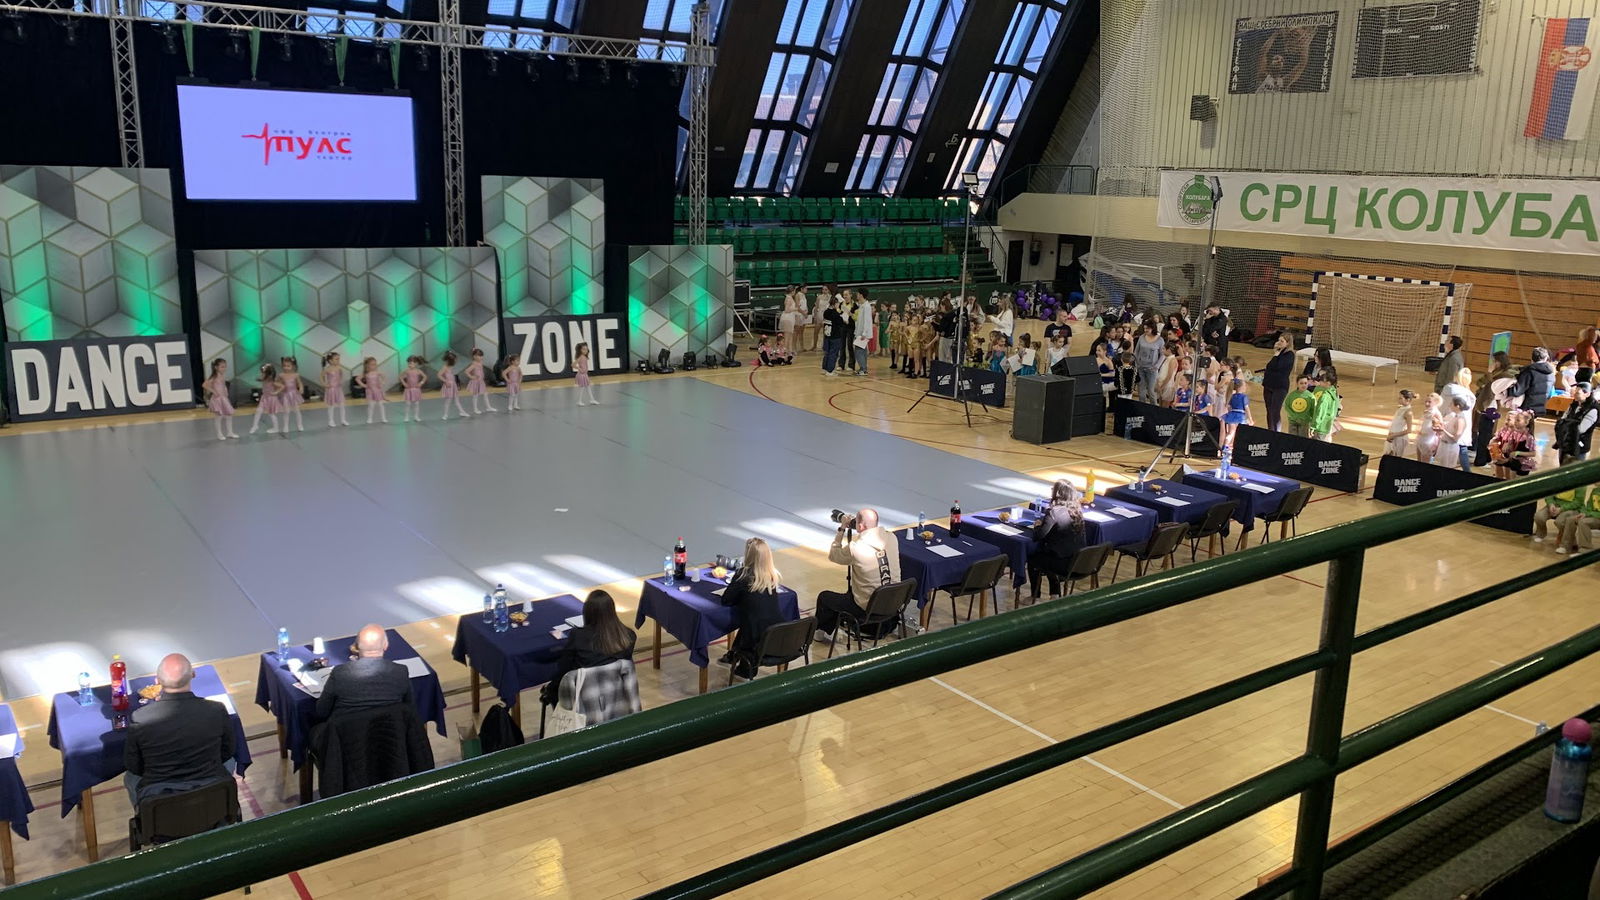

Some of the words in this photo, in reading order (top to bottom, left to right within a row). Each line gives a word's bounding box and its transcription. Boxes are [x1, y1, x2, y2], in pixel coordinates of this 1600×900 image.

[1231, 38, 1242, 91] СТЕФАН
[1239, 182, 1338, 234] СРЦ
[1355, 187, 1599, 242] КОЛУБА
[513, 318, 620, 376] ZONE
[11, 341, 192, 415] DANCE
[1248, 443, 1270, 451] DANCE
[1281, 451, 1305, 459] DANCE
[1284, 458, 1302, 466] ZONE
[1318, 460, 1342, 468] DANCE
[1321, 466, 1339, 474] ZONE
[1394, 478, 1421, 487] DANCE
[1397, 485, 1418, 493] ZONE
